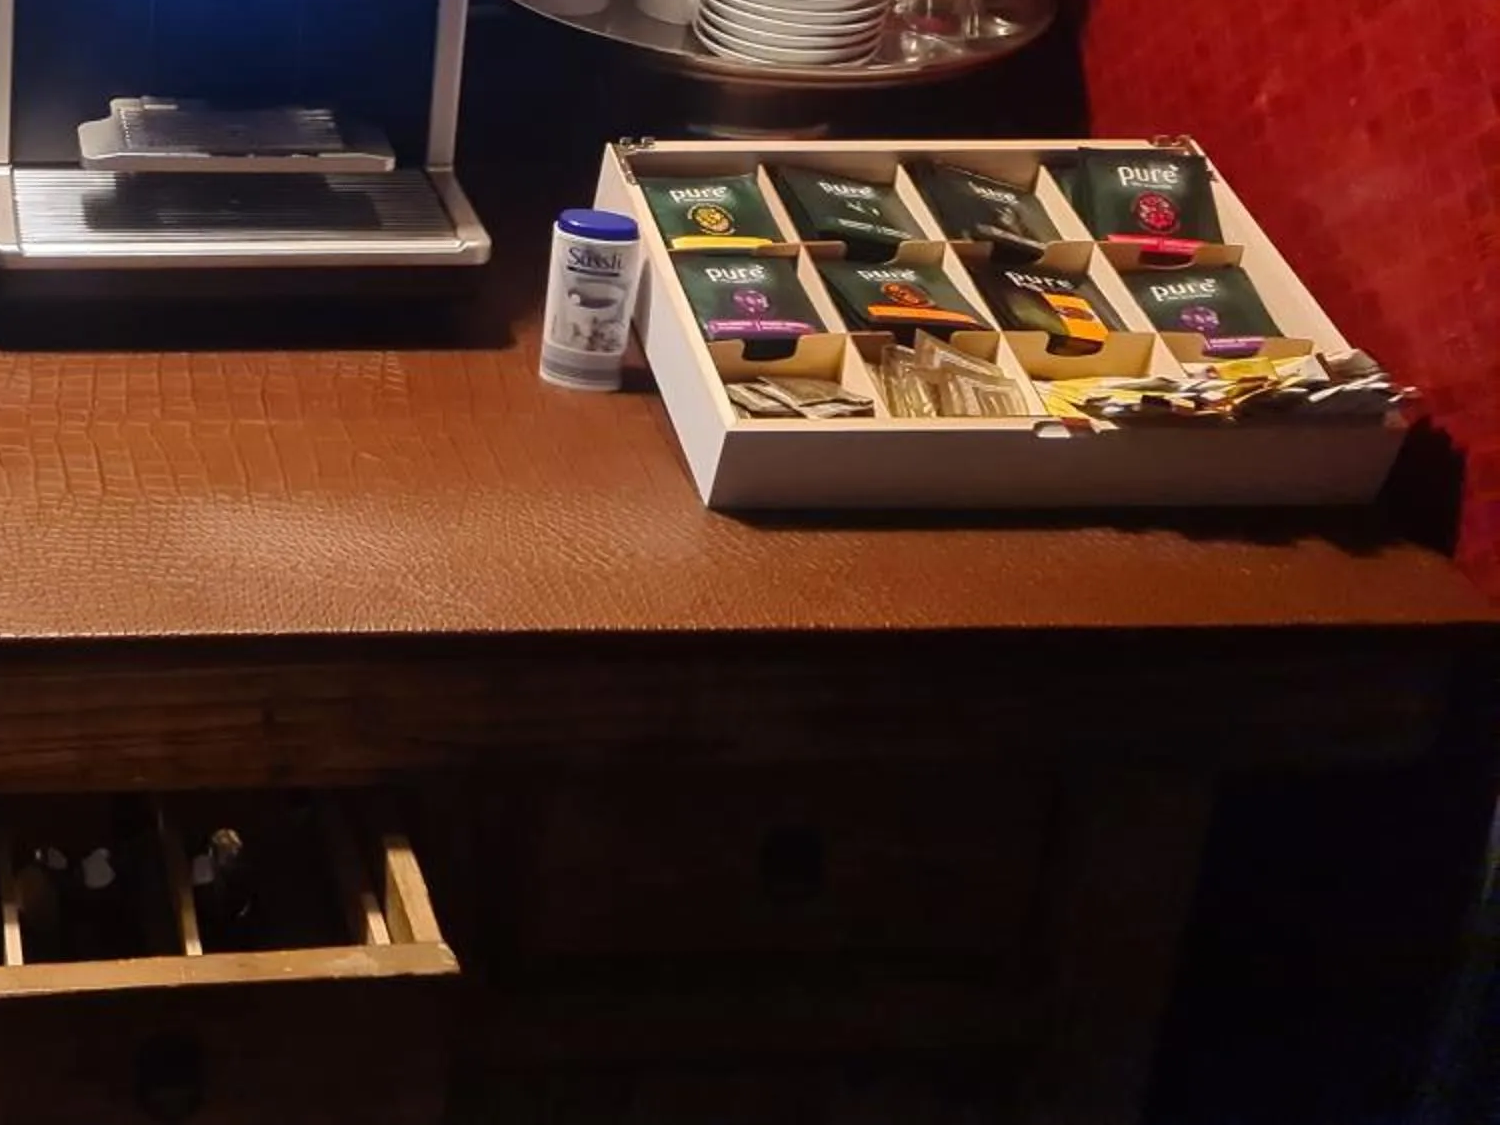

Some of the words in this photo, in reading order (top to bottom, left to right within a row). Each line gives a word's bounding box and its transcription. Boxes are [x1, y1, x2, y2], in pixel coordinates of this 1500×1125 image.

[1117, 163, 1179, 188] pure
[669, 184, 728, 203] pure
[704, 264, 766, 283] pure
[857, 266, 917, 283] pure
[1150, 277, 1217, 301] pure
